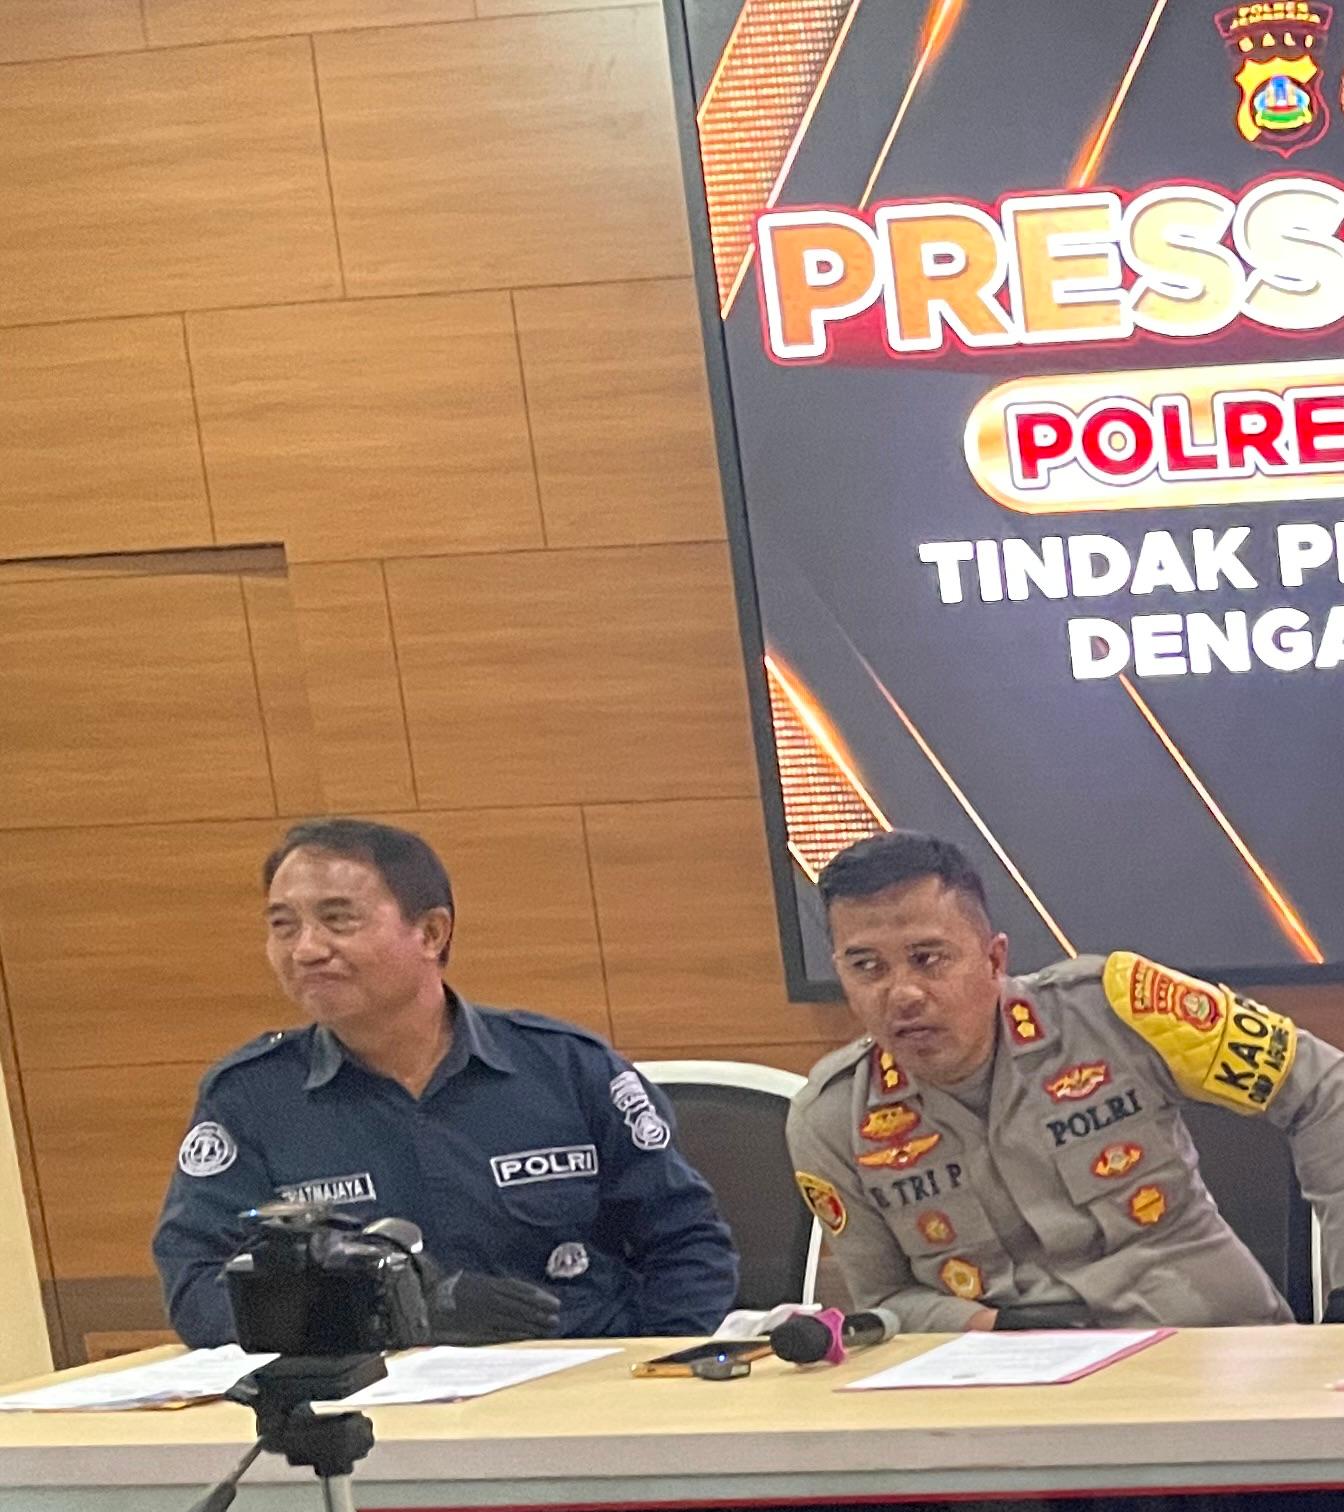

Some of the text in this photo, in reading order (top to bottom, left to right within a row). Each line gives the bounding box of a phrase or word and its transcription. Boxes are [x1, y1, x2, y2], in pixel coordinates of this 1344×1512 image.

[919, 526, 1258, 604] TINDAK
[1046, 1088, 1142, 1147] POLRI
[501, 1152, 591, 1180] POLRI
[892, 1170, 939, 1206] TRI
[946, 1163, 962, 1189] P
